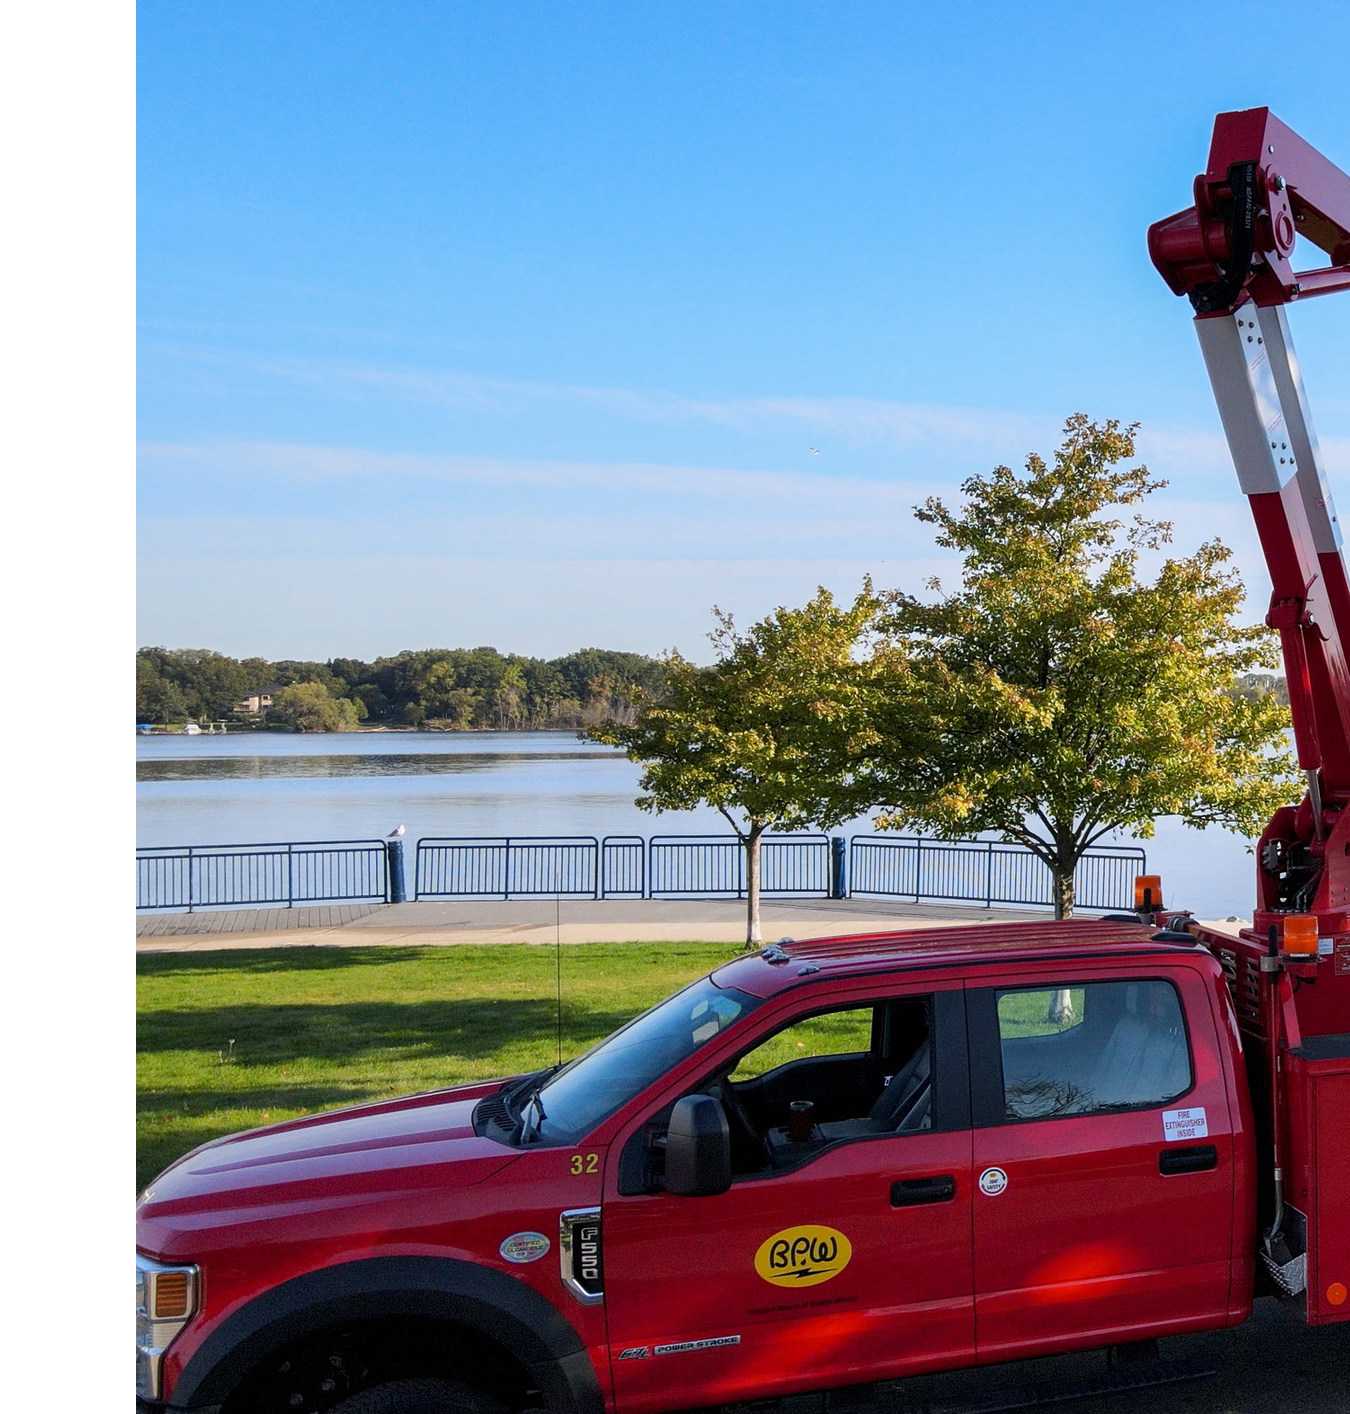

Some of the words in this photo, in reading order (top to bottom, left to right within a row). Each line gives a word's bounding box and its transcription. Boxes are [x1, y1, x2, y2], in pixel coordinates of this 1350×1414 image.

[1177, 1110, 1190, 1119] FIRE
[1165, 1117, 1205, 1130] EXTINGUISHER
[1176, 1128, 1196, 1138] INSIDE
[570, 1153, 599, 1175] 32
[581, 1227, 598, 1279] F550
[657, 1343, 694, 1353] POWER
[696, 1336, 739, 1347] STROKE
